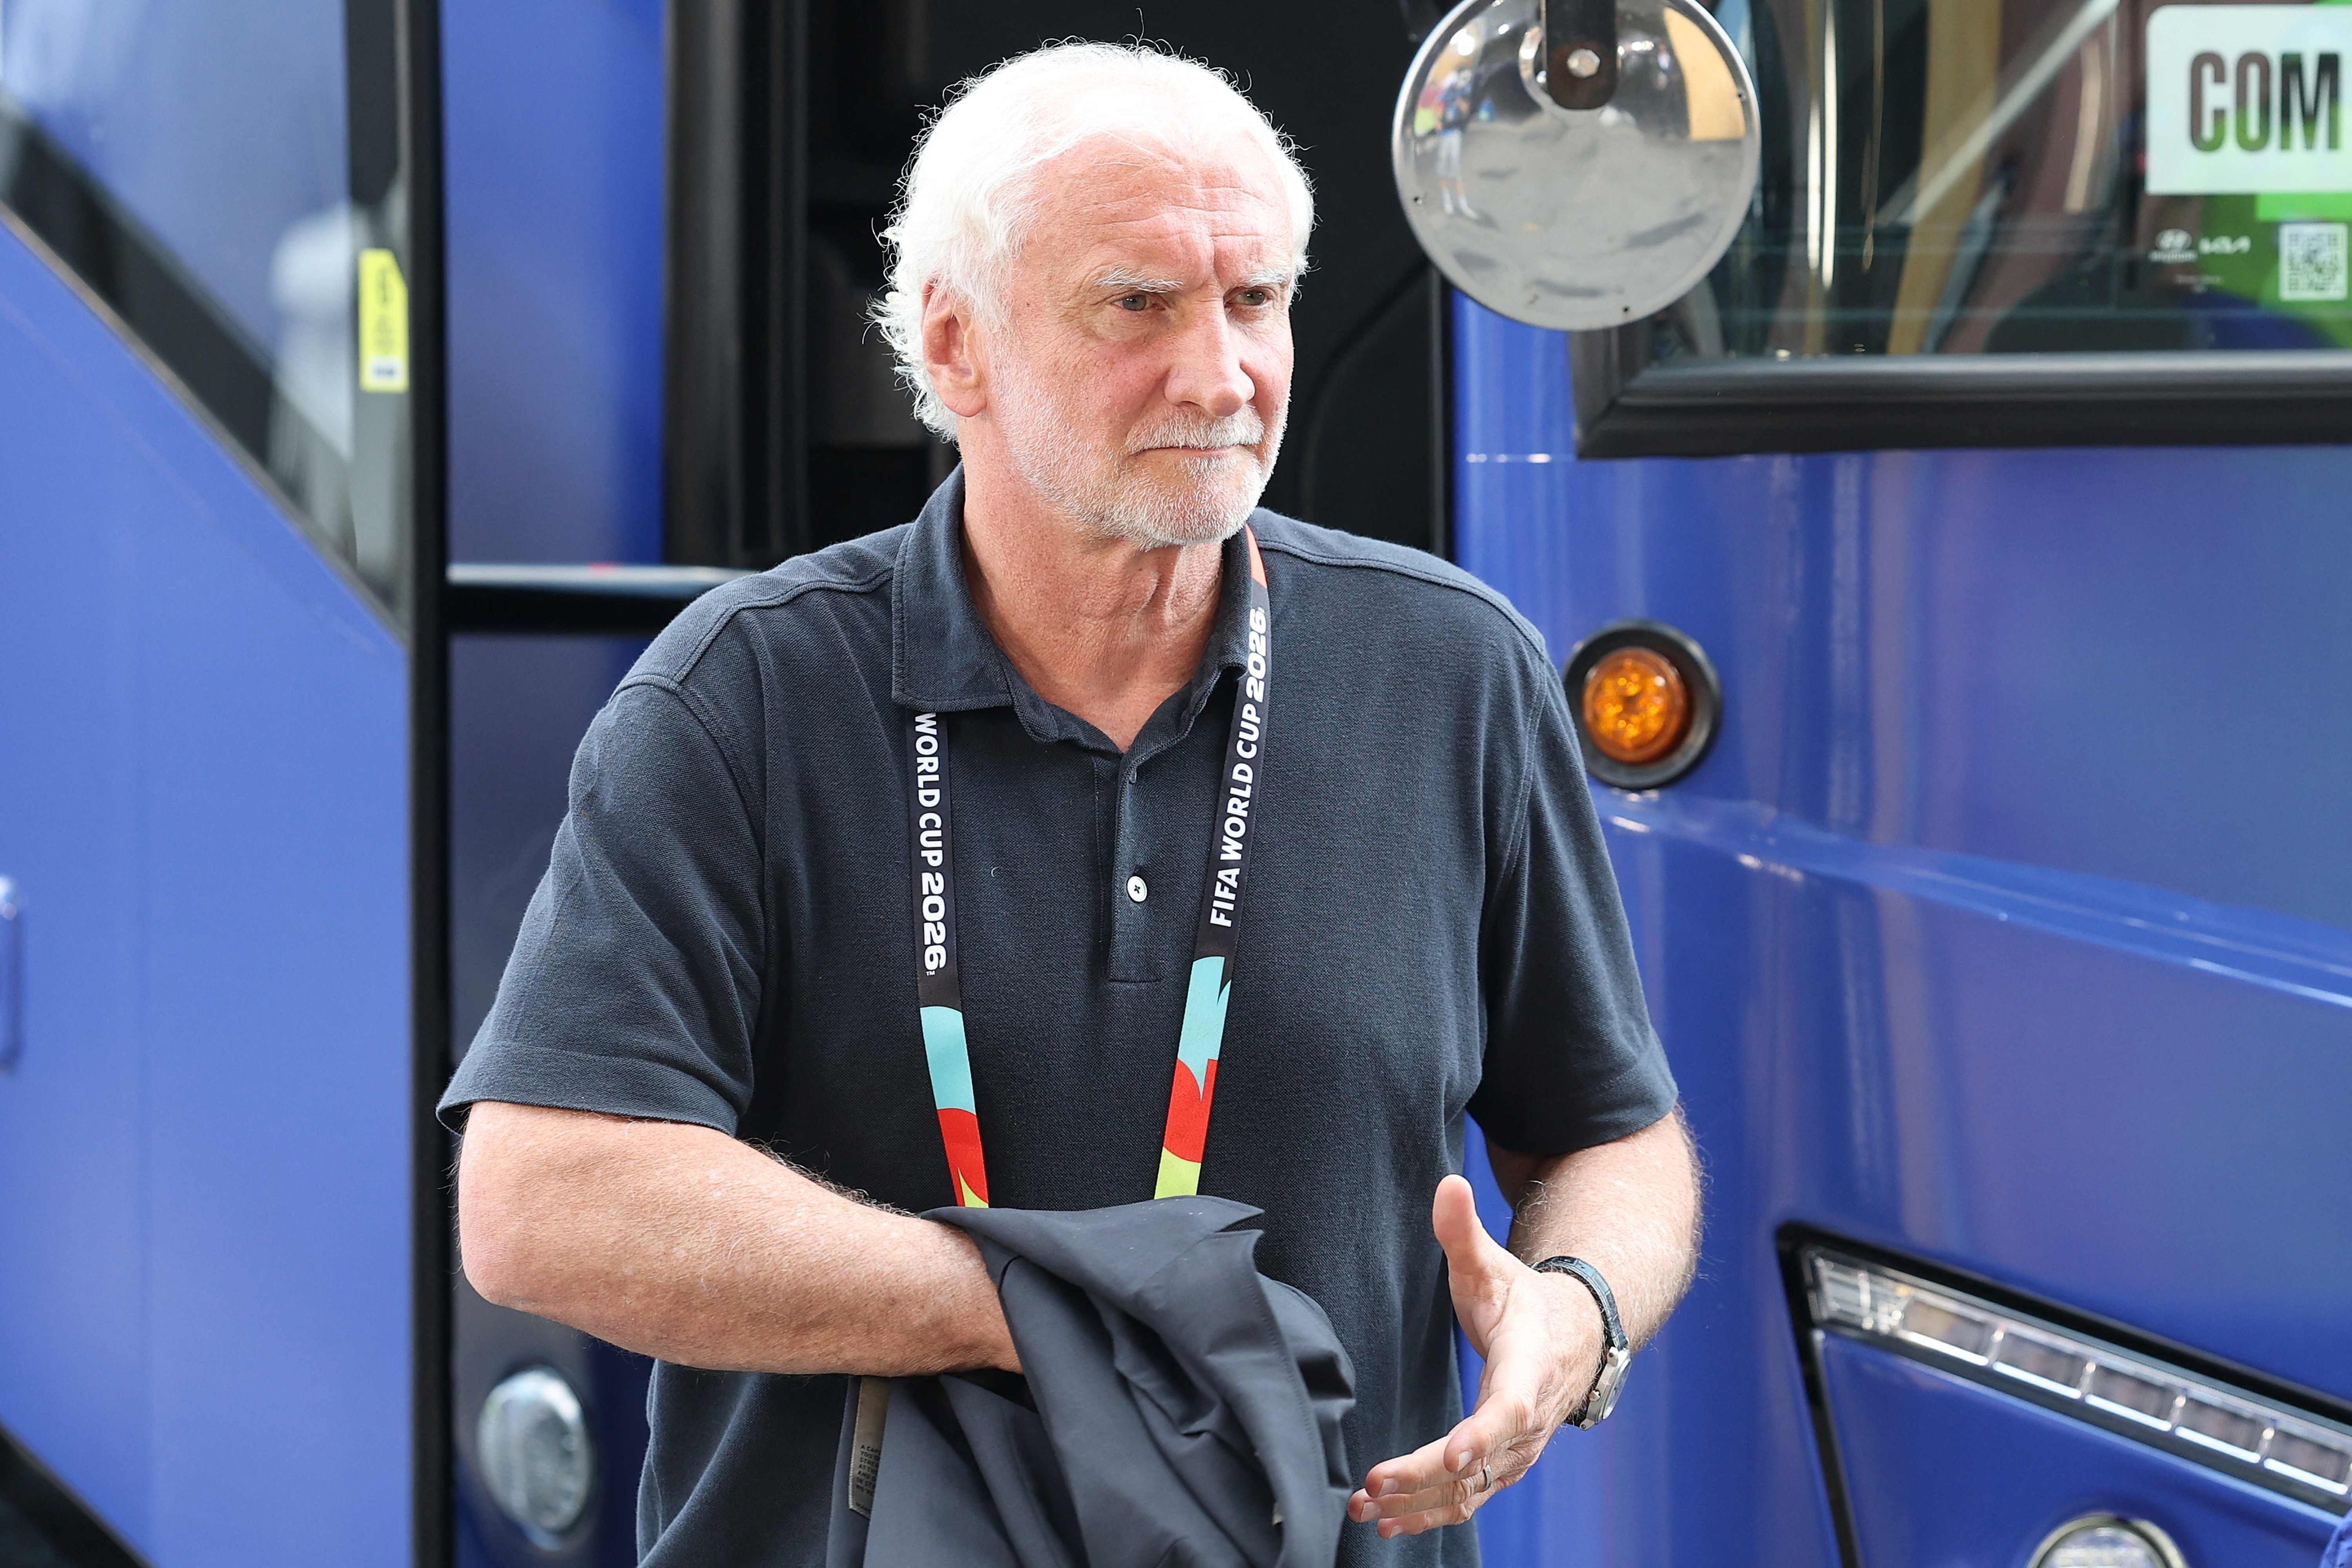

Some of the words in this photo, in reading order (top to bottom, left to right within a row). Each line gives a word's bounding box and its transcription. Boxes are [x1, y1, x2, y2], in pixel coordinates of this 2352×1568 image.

[2190, 52, 2340, 152] COM
[915, 713, 940, 807] WORLD
[1237, 703, 1261, 759] CUP
[919, 813, 943, 867] CUP
[1220, 763, 1253, 860] WORLD
[1210, 868, 1240, 927] FIFA
